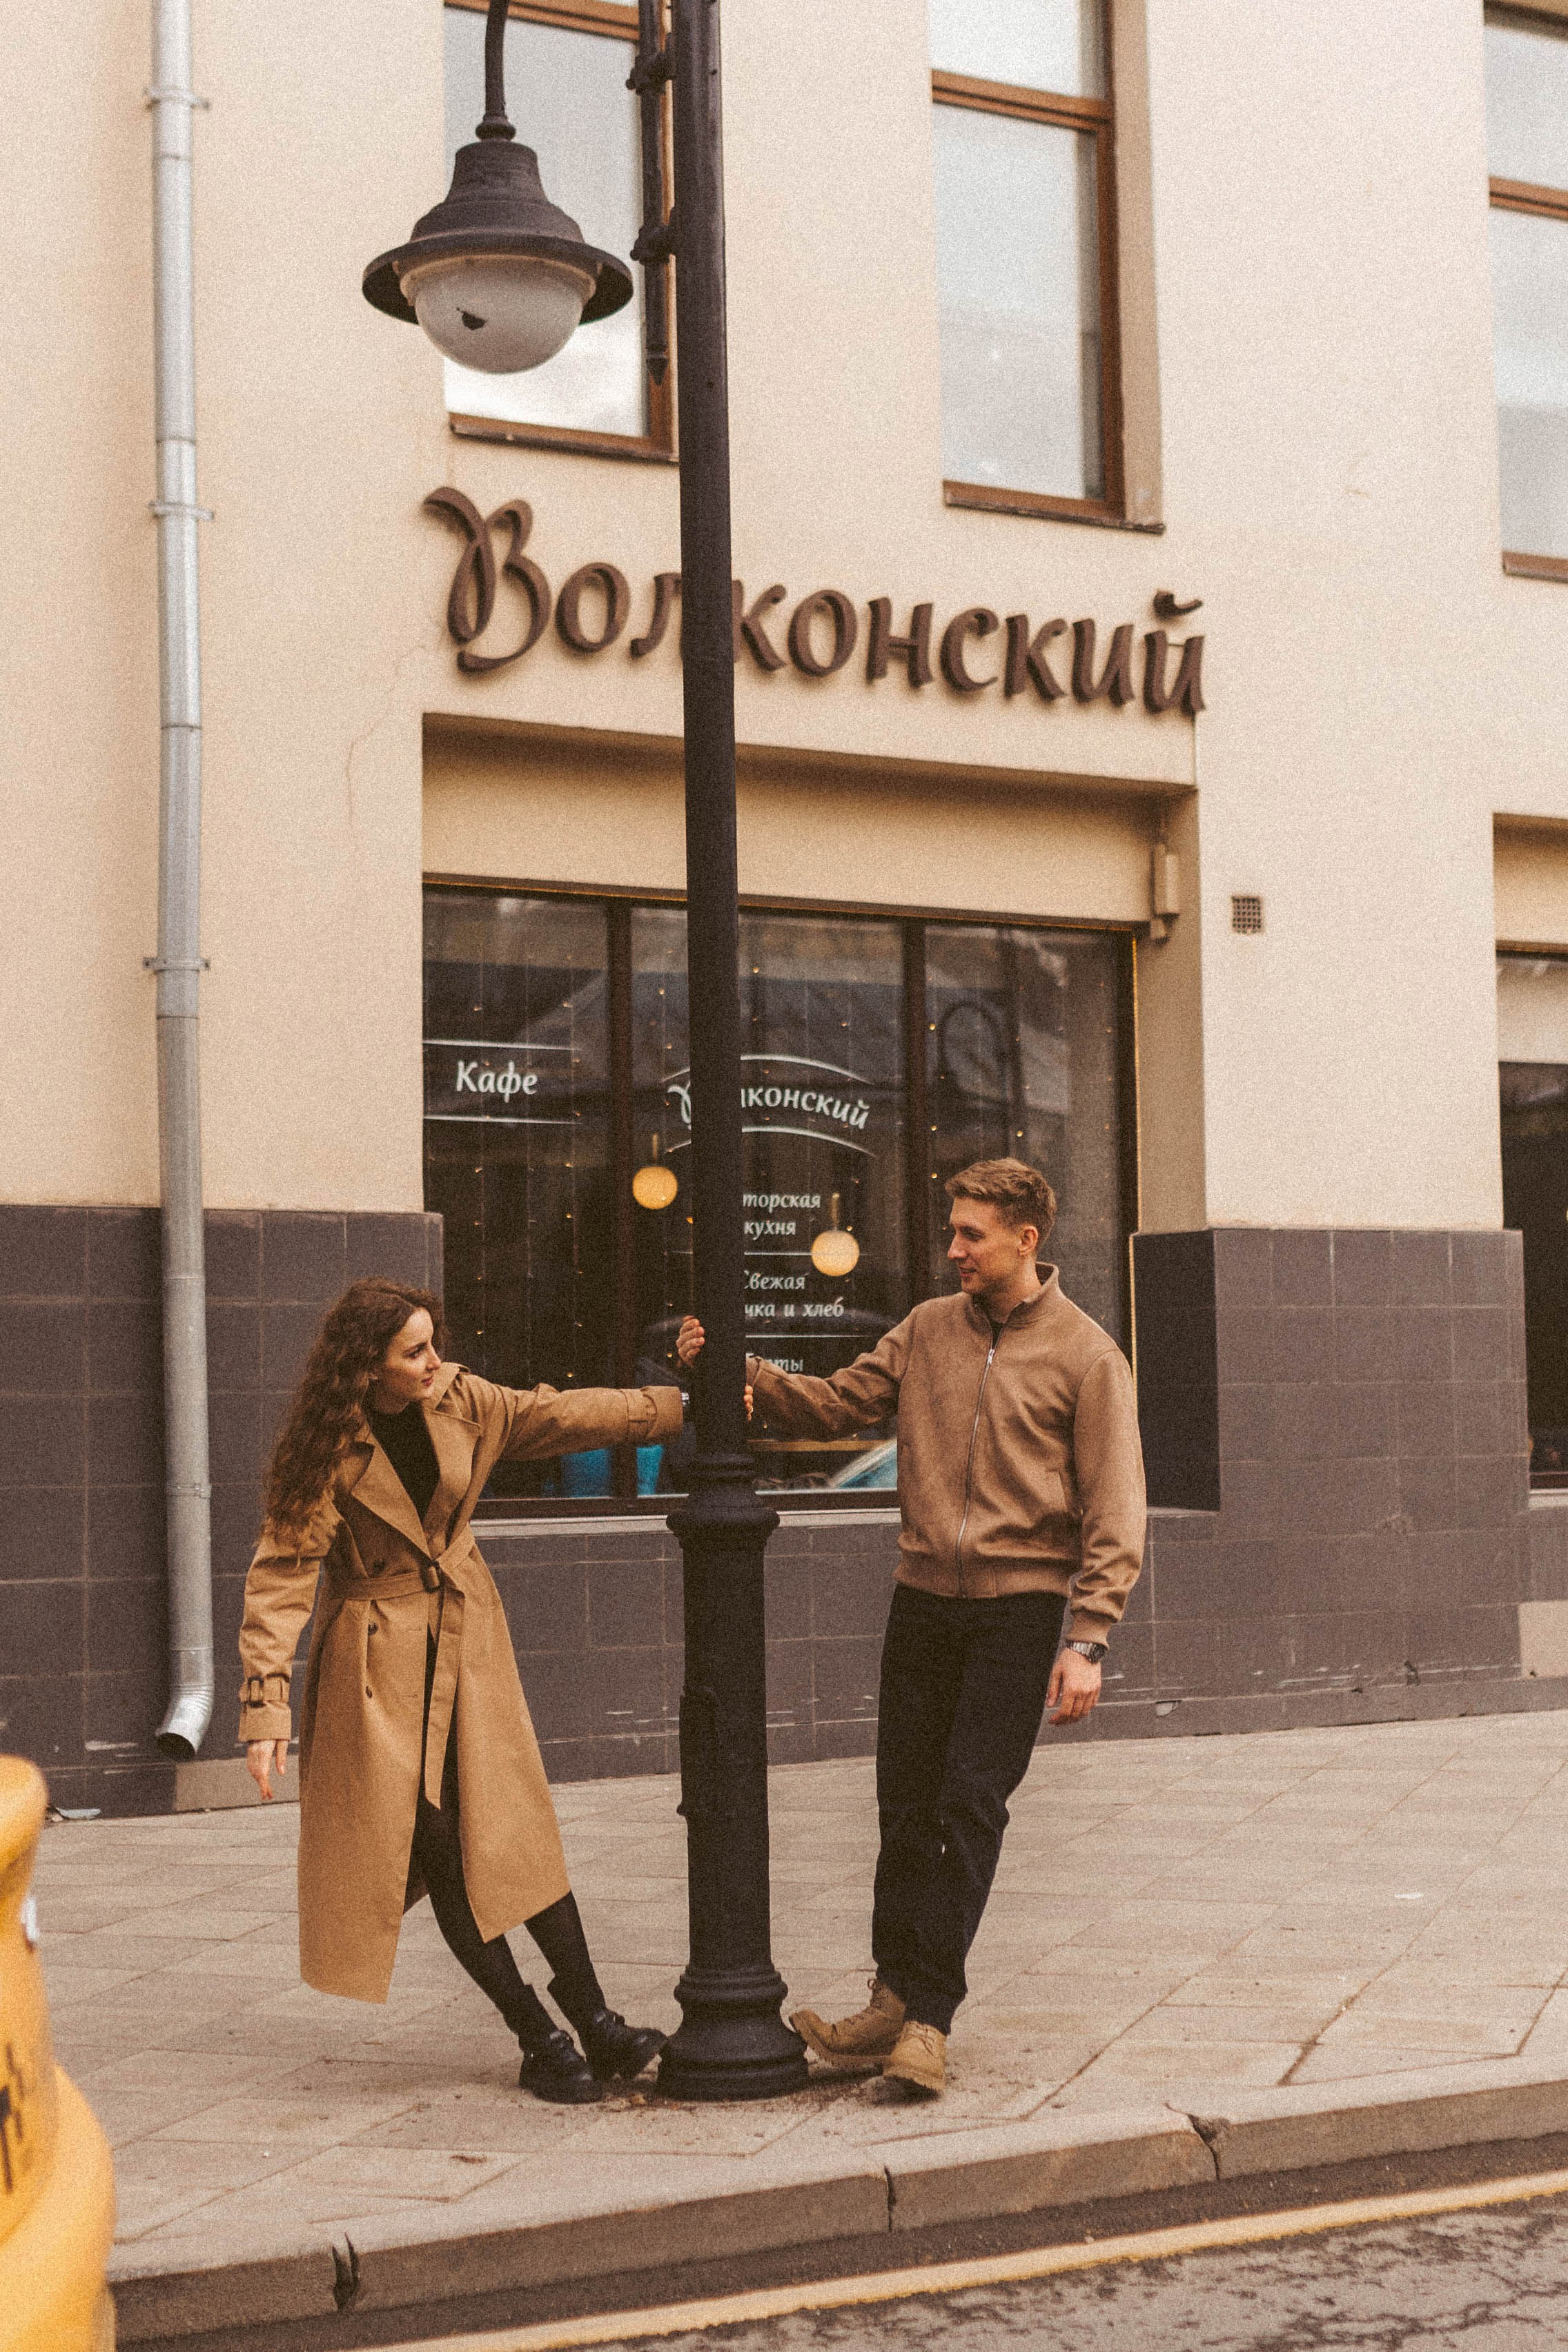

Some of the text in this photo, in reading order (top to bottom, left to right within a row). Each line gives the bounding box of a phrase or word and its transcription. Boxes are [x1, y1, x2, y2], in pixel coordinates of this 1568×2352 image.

[455, 1060, 538, 1104] Кафе
[743, 1193, 821, 1213] торская
[744, 1221, 796, 1240] кухня
[784, 1304, 795, 1317] и
[803, 1296, 845, 1317] хлеб
